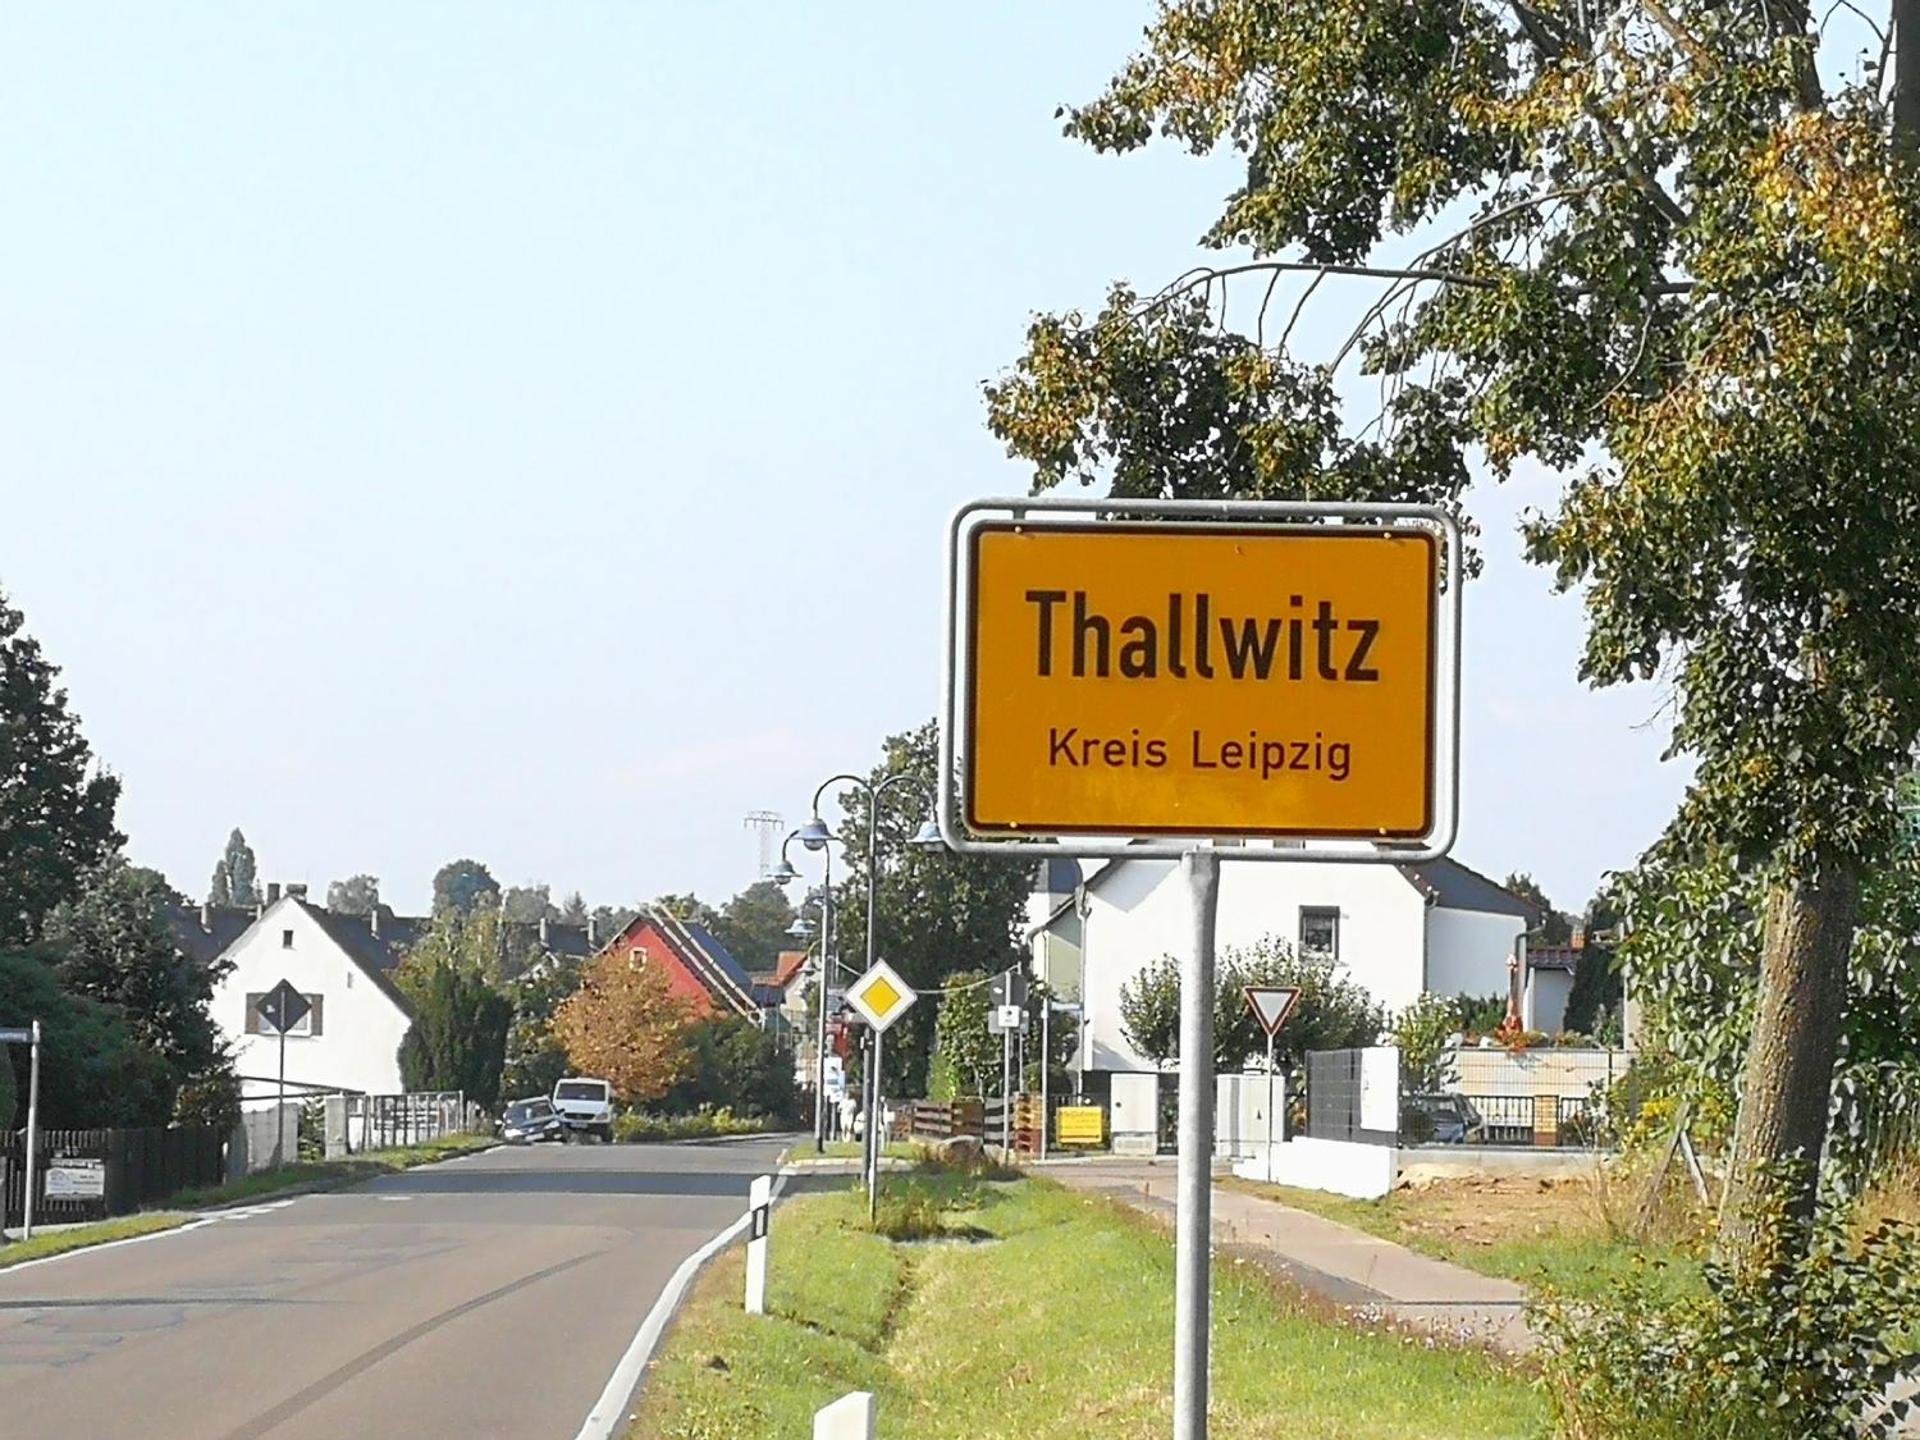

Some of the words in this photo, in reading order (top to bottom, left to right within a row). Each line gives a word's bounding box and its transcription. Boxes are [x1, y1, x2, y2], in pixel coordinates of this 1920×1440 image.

[1025, 590, 1380, 682] Thallwitz
[1049, 728, 1168, 767] Kreis
[1193, 730, 1351, 781] Leipzig
